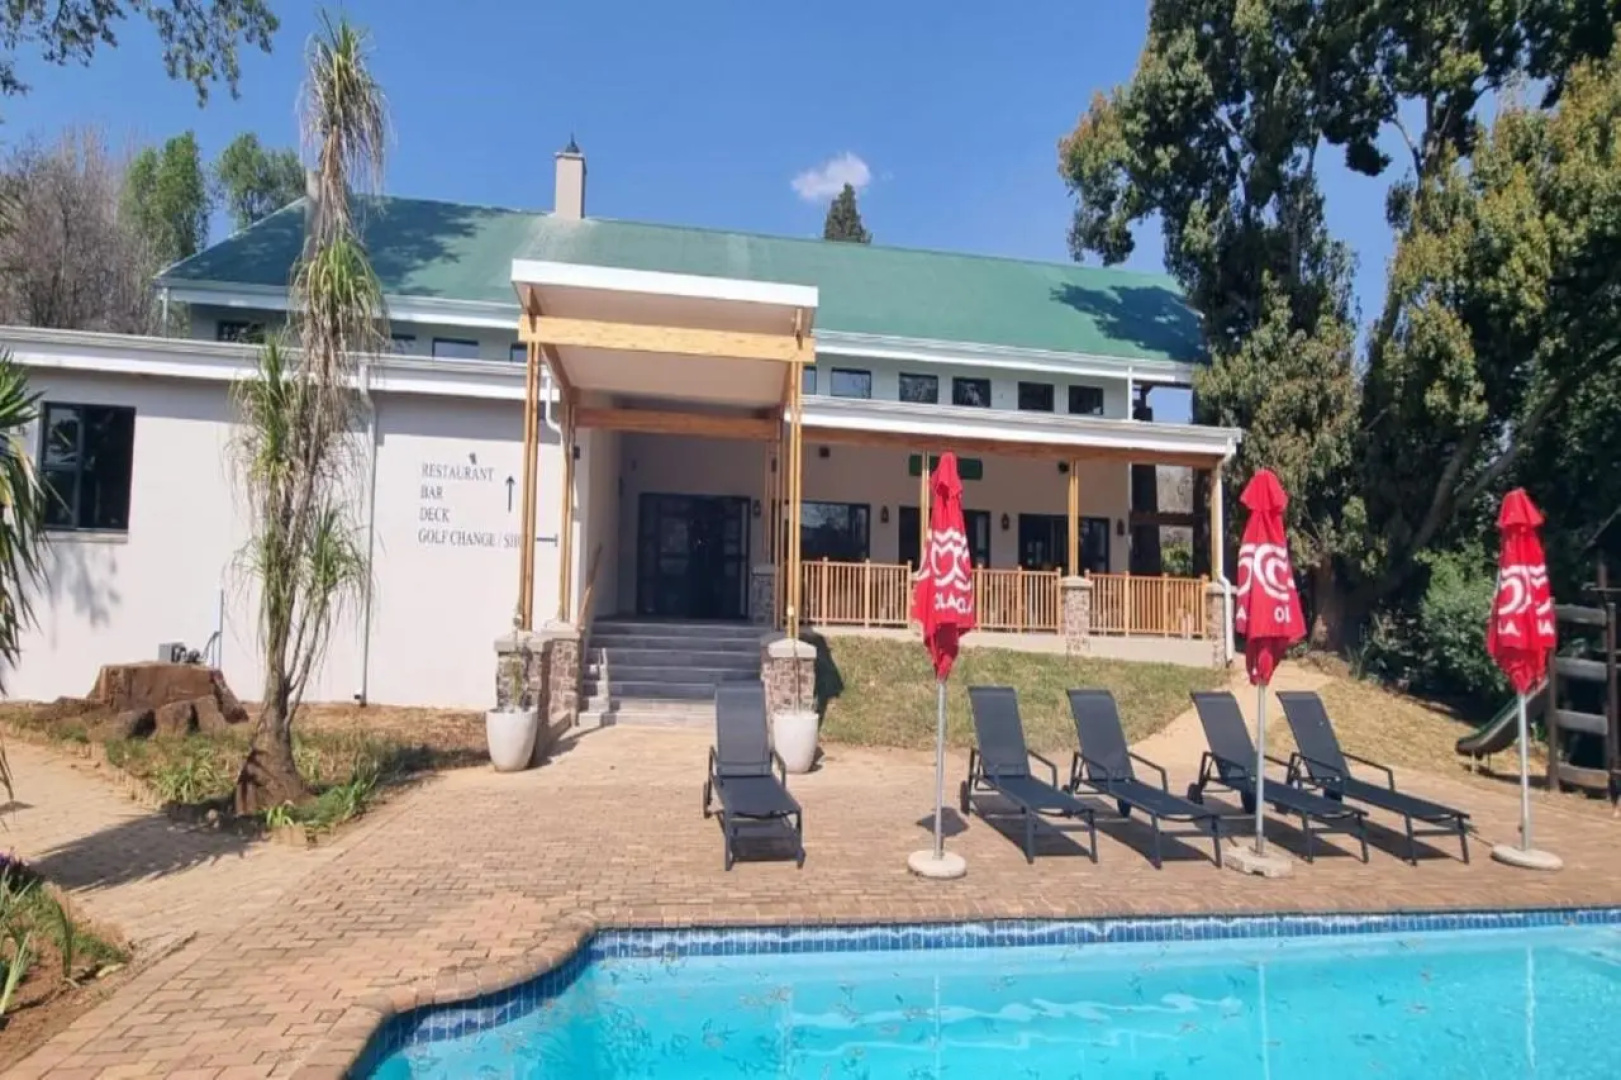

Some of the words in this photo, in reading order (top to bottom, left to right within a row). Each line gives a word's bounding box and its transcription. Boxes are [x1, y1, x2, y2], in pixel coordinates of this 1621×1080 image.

[421, 463, 494, 482] RESTAURANT
[420, 484, 443, 499] BAR
[419, 507, 450, 523] DECK
[418, 528, 448, 544] GOLF
[450, 530, 495, 547] CHANGE
